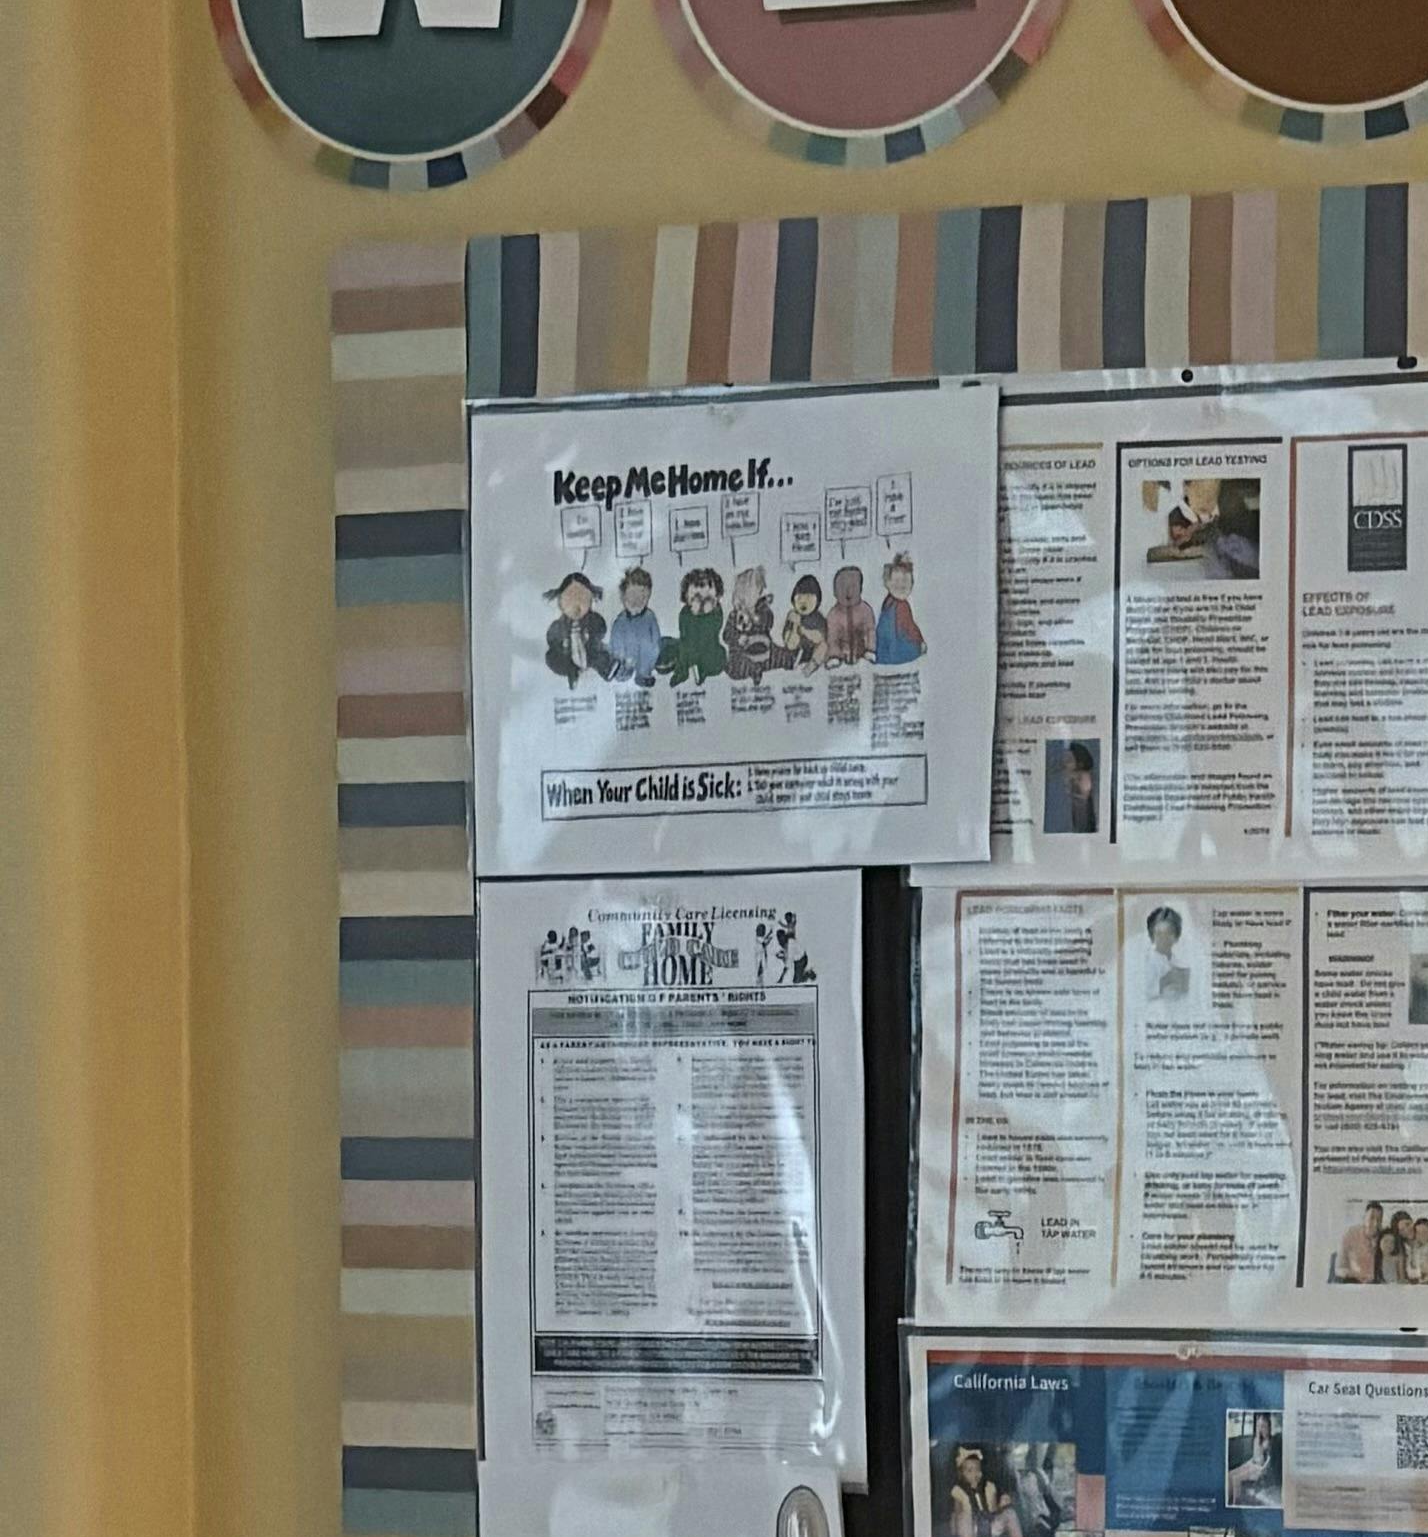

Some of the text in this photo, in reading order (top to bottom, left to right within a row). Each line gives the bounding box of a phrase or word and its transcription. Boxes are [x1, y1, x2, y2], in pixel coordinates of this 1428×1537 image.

[554, 470, 621, 511] Keep
[624, 467, 665, 497] Me
[748, 458, 793, 489] If...
[1354, 511, 1402, 529] CDSS
[547, 782, 592, 806] When
[597, 778, 632, 803] Your
[636, 774, 678, 800] Child
[683, 777, 695, 799] is
[698, 772, 741, 799] Sick:
[954, 1374, 1068, 1390] California Laws
[1309, 1382, 1428, 1398] Car Seat Questions
